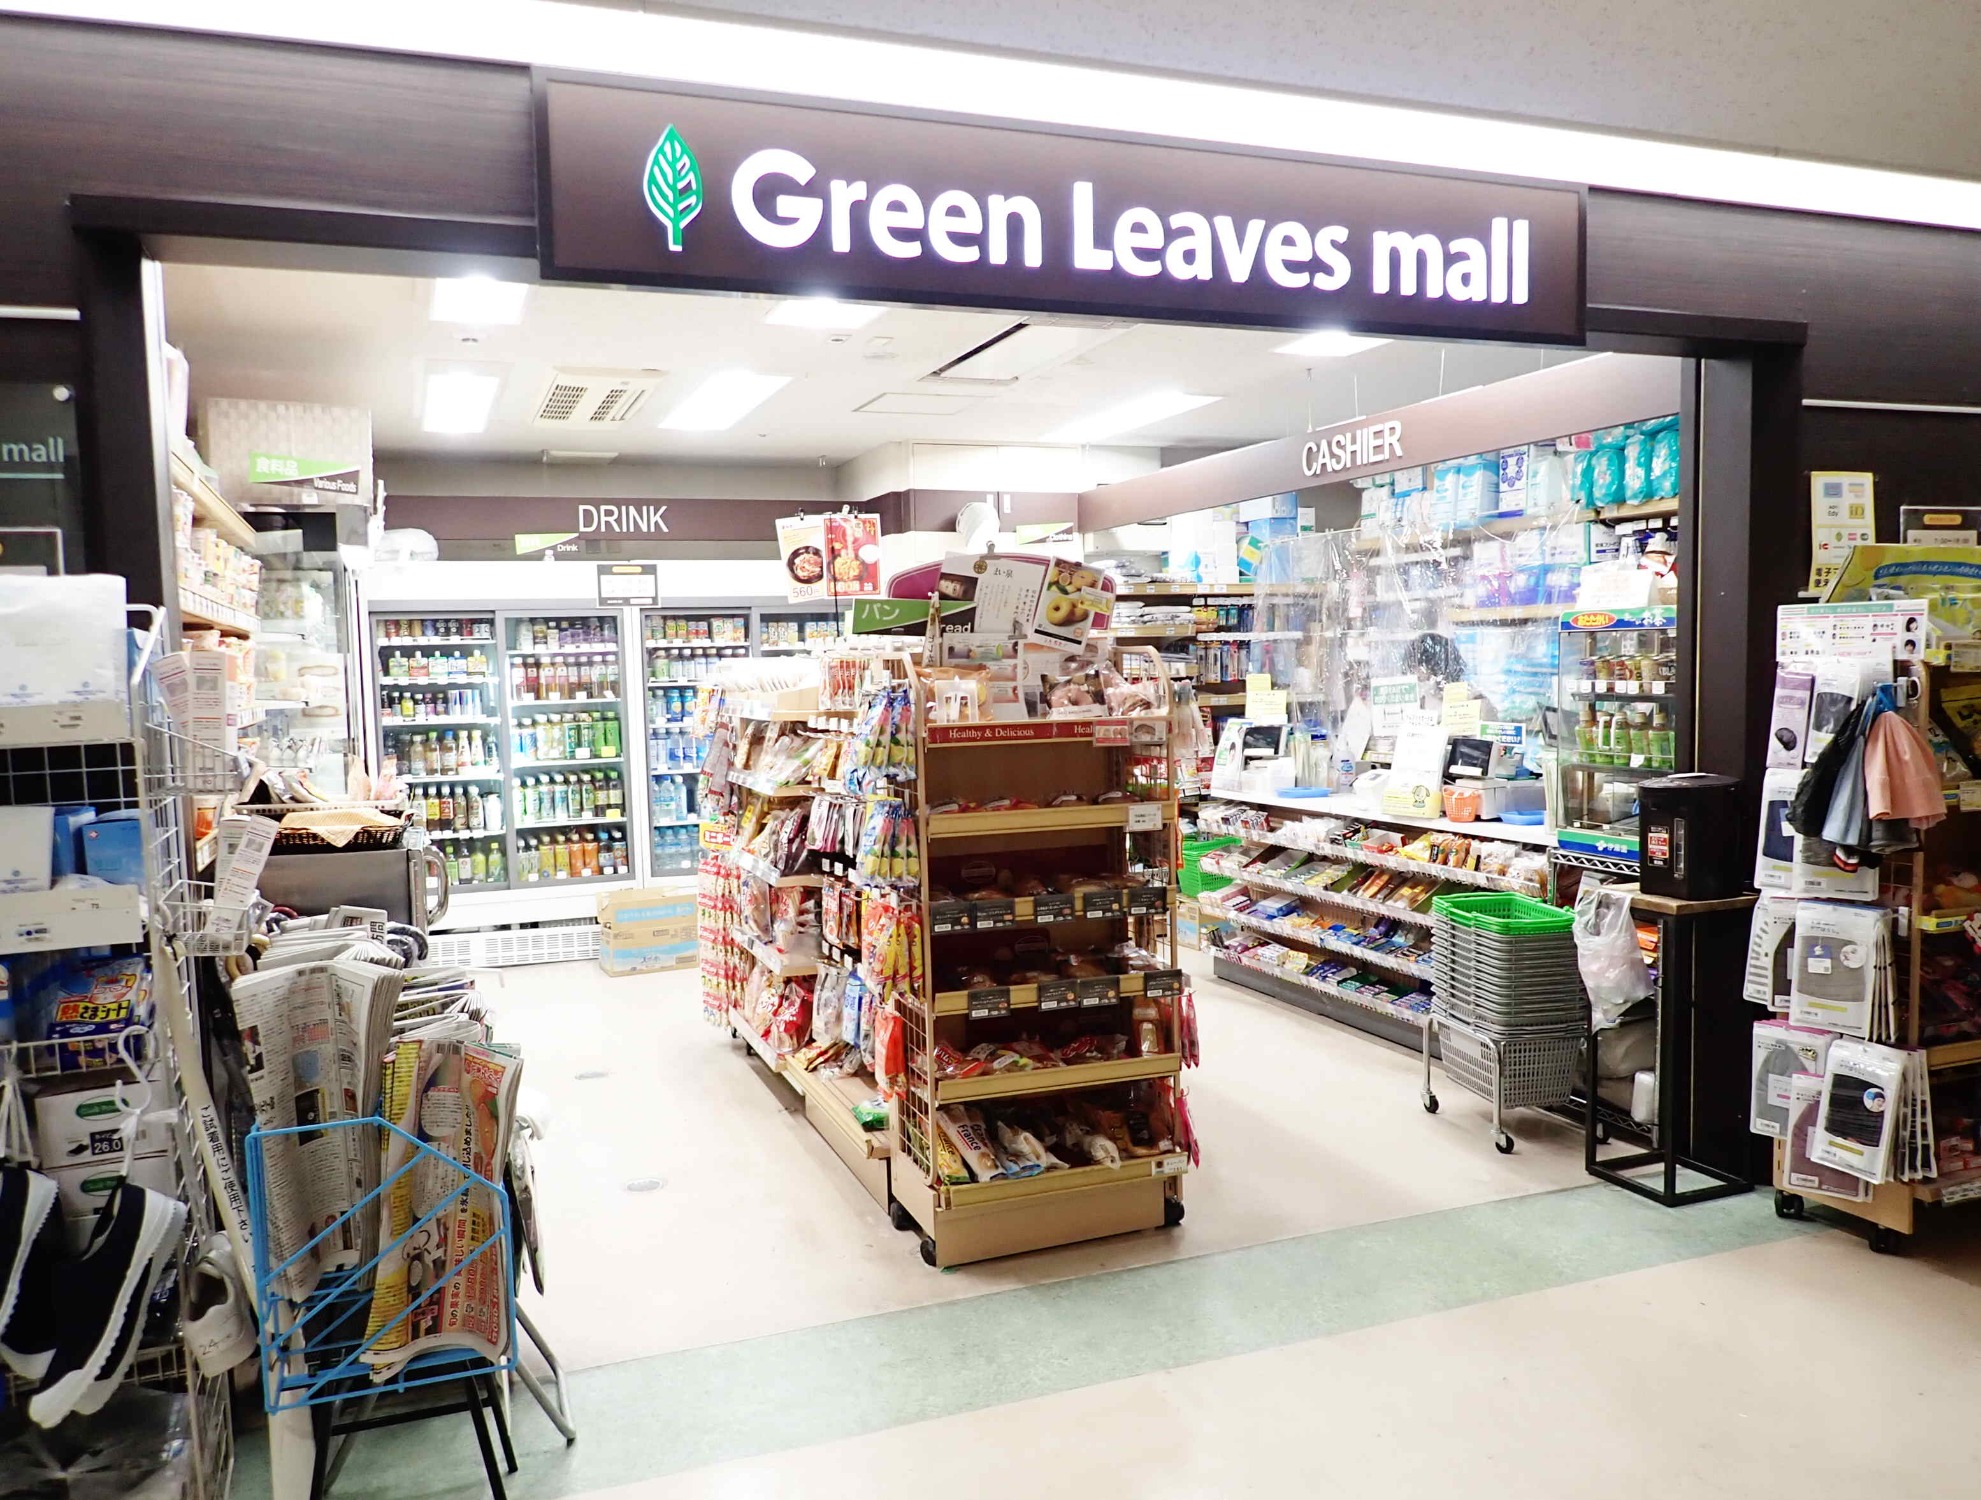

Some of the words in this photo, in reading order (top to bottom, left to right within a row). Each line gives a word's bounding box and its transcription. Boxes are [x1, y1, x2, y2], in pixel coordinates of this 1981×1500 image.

[731, 147, 1043, 269] Green
[1072, 180, 1352, 292] Leaves
[1372, 216, 1530, 305] mall
[2, 436, 65, 463] mall
[1301, 419, 1404, 478] CASHIER
[313, 477, 337, 491] Various
[336, 480, 357, 493] Foods
[578, 504, 670, 533] DRINK
[557, 543, 579, 552] Drink
[861, 602, 900, 621] パン
[941, 621, 972, 634] read
[949, 728, 982, 740] Healthy
[984, 728, 992, 738] &
[995, 726, 1035, 737] Delicious
[1074, 724, 1093, 735] Heal
[958, 1123, 982, 1151] France
[94, 1139, 122, 1154] 26.0
